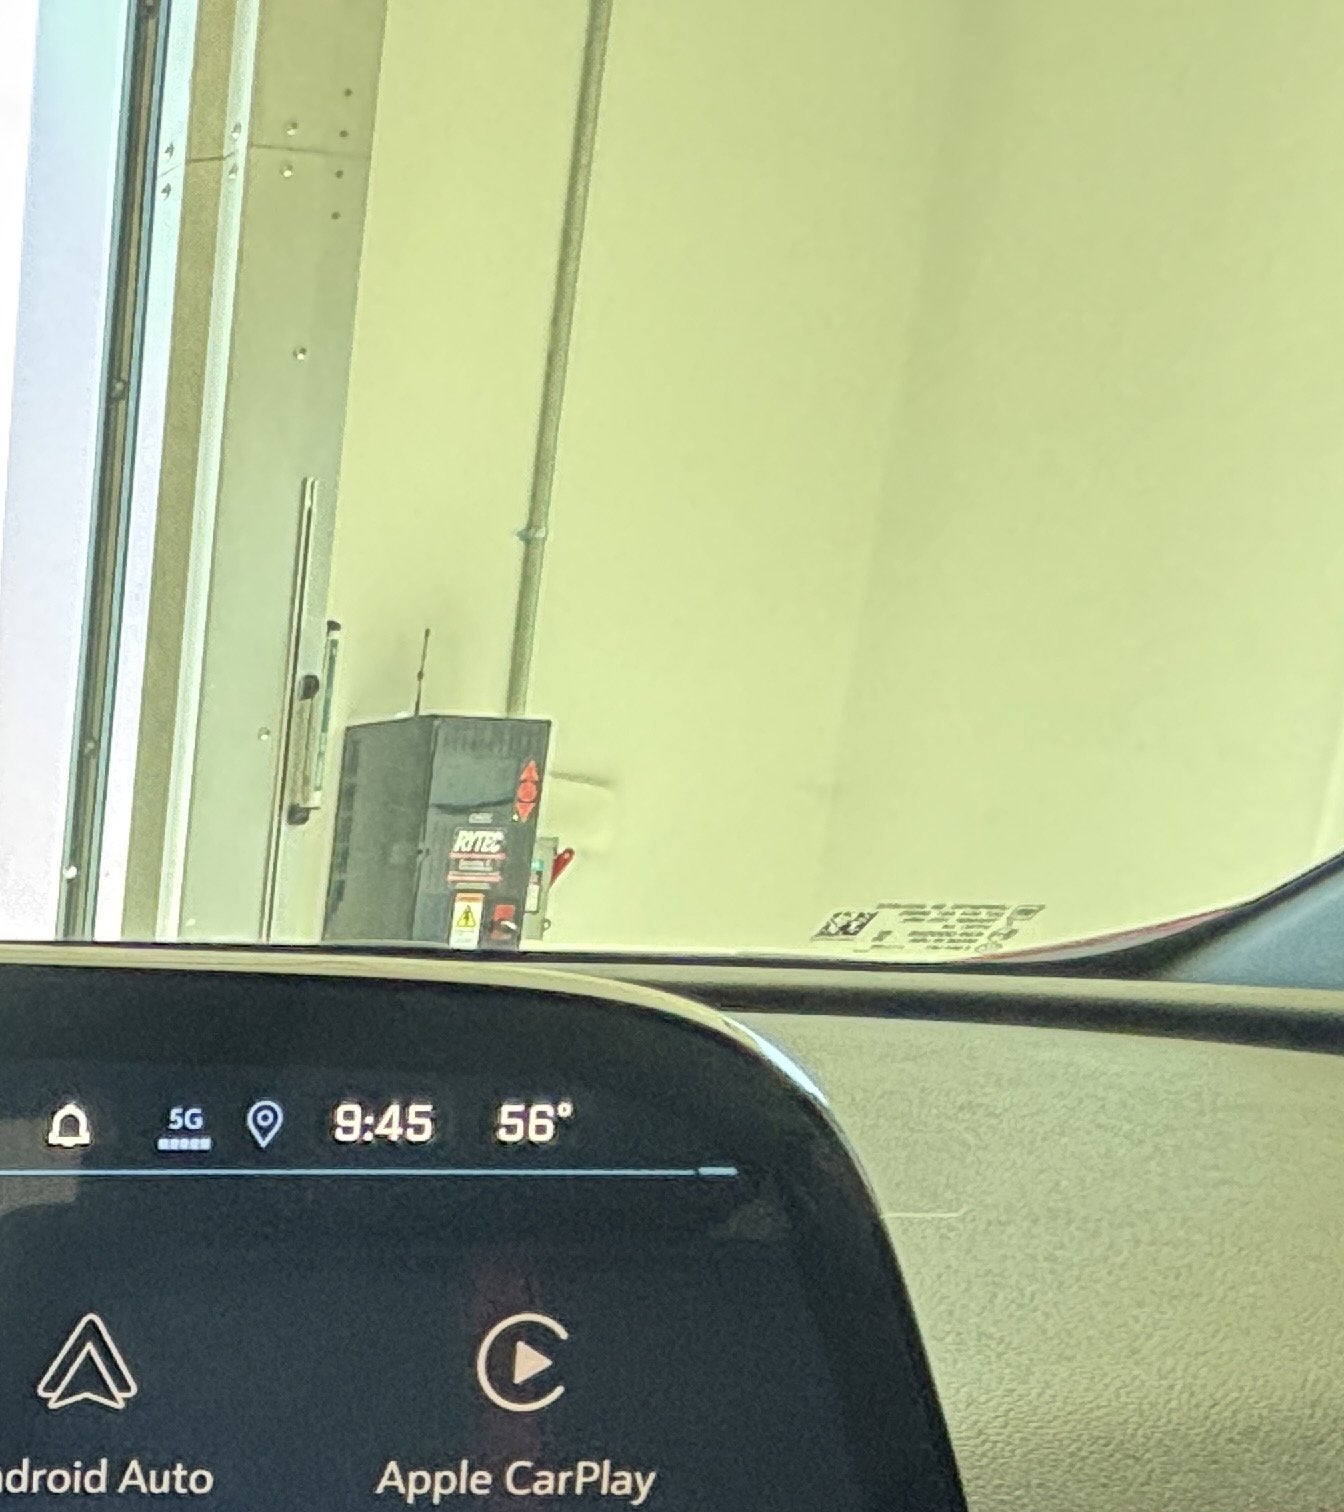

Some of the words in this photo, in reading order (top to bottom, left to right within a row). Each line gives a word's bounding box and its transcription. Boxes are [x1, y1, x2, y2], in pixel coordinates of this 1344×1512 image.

[166, 1105, 205, 1131] 5G
[333, 1100, 434, 1143] 9:45
[495, 1099, 575, 1143] 56°
[116, 1458, 215, 1495] Auto
[374, 1458, 493, 1506] Apple
[504, 1458, 658, 1507] CarPlay
